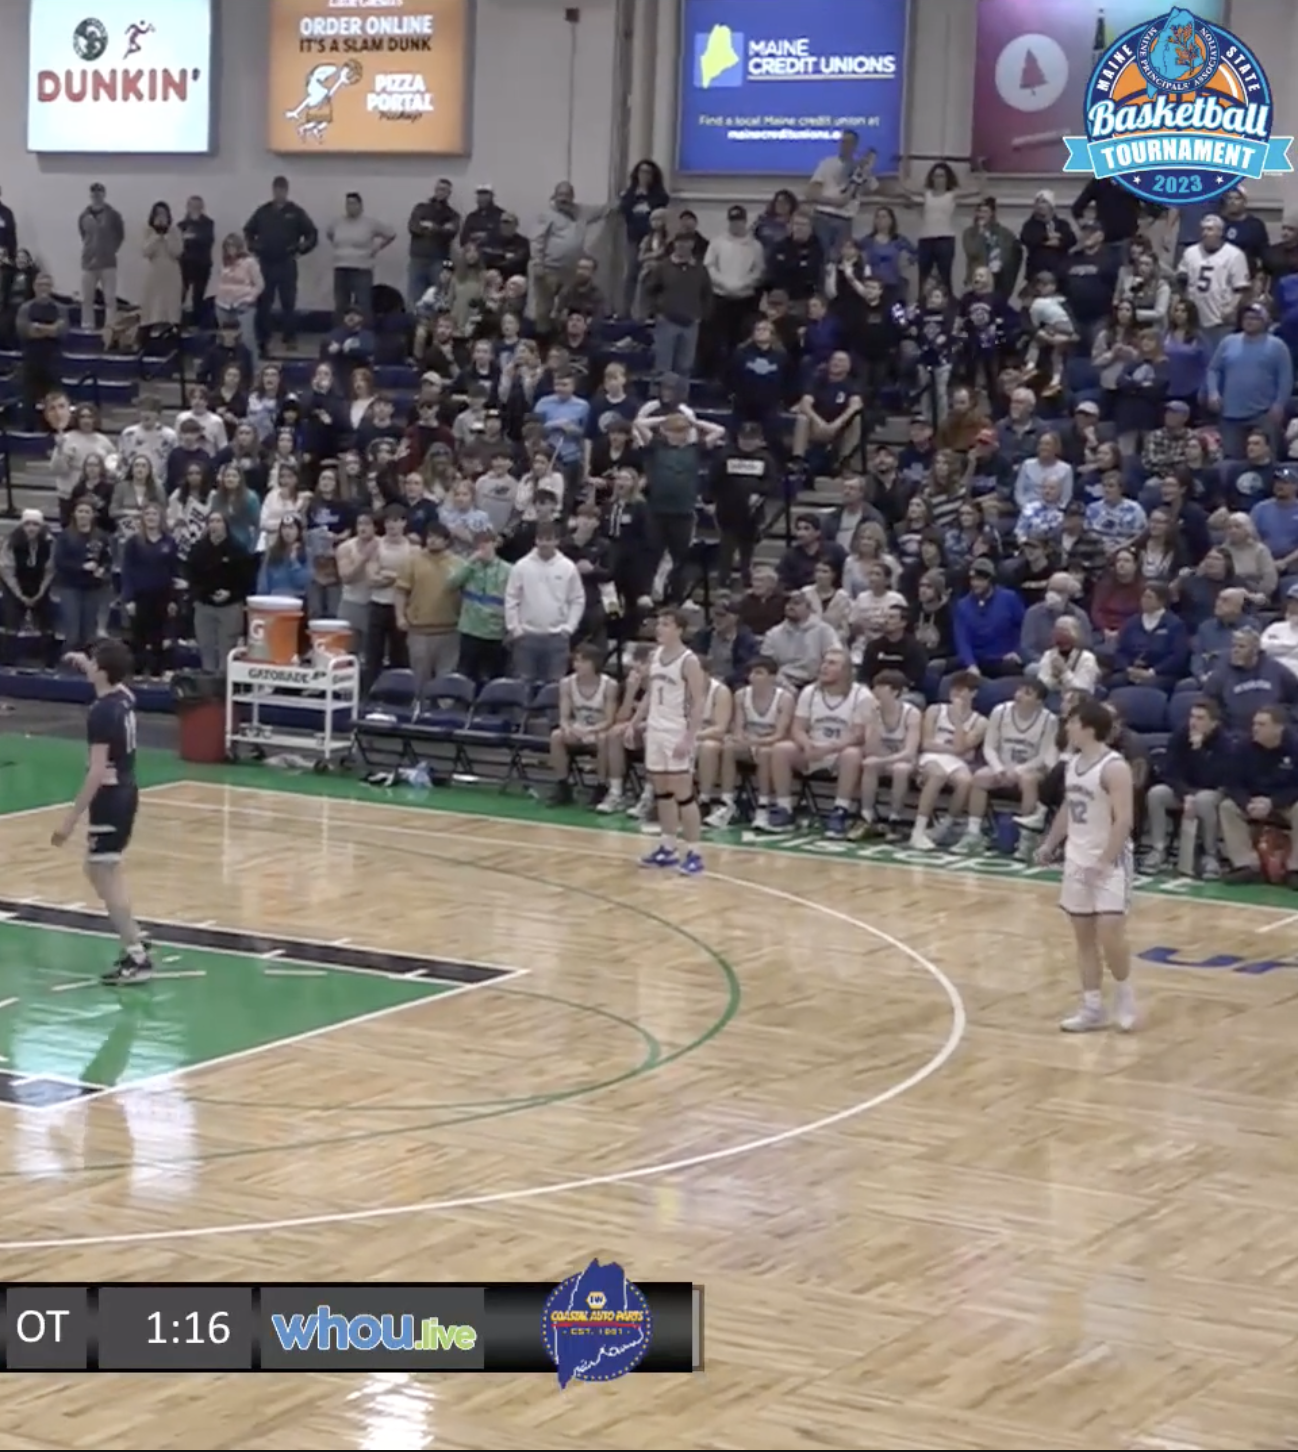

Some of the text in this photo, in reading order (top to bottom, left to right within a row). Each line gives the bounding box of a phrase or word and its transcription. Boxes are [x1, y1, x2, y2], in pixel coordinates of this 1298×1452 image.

[300, 15, 433, 35] ORDER ONLINE
[299, 36, 432, 53] IT'S A SLAM DUNK
[748, 38, 809, 56] MAINE
[748, 56, 896, 74] CREDIT UNIONS
[37, 67, 201, 102] DUNKIN'
[375, 74, 426, 92] PIZZA
[366, 92, 433, 111] PORTAL
[1196, 265, 1212, 293] 5
